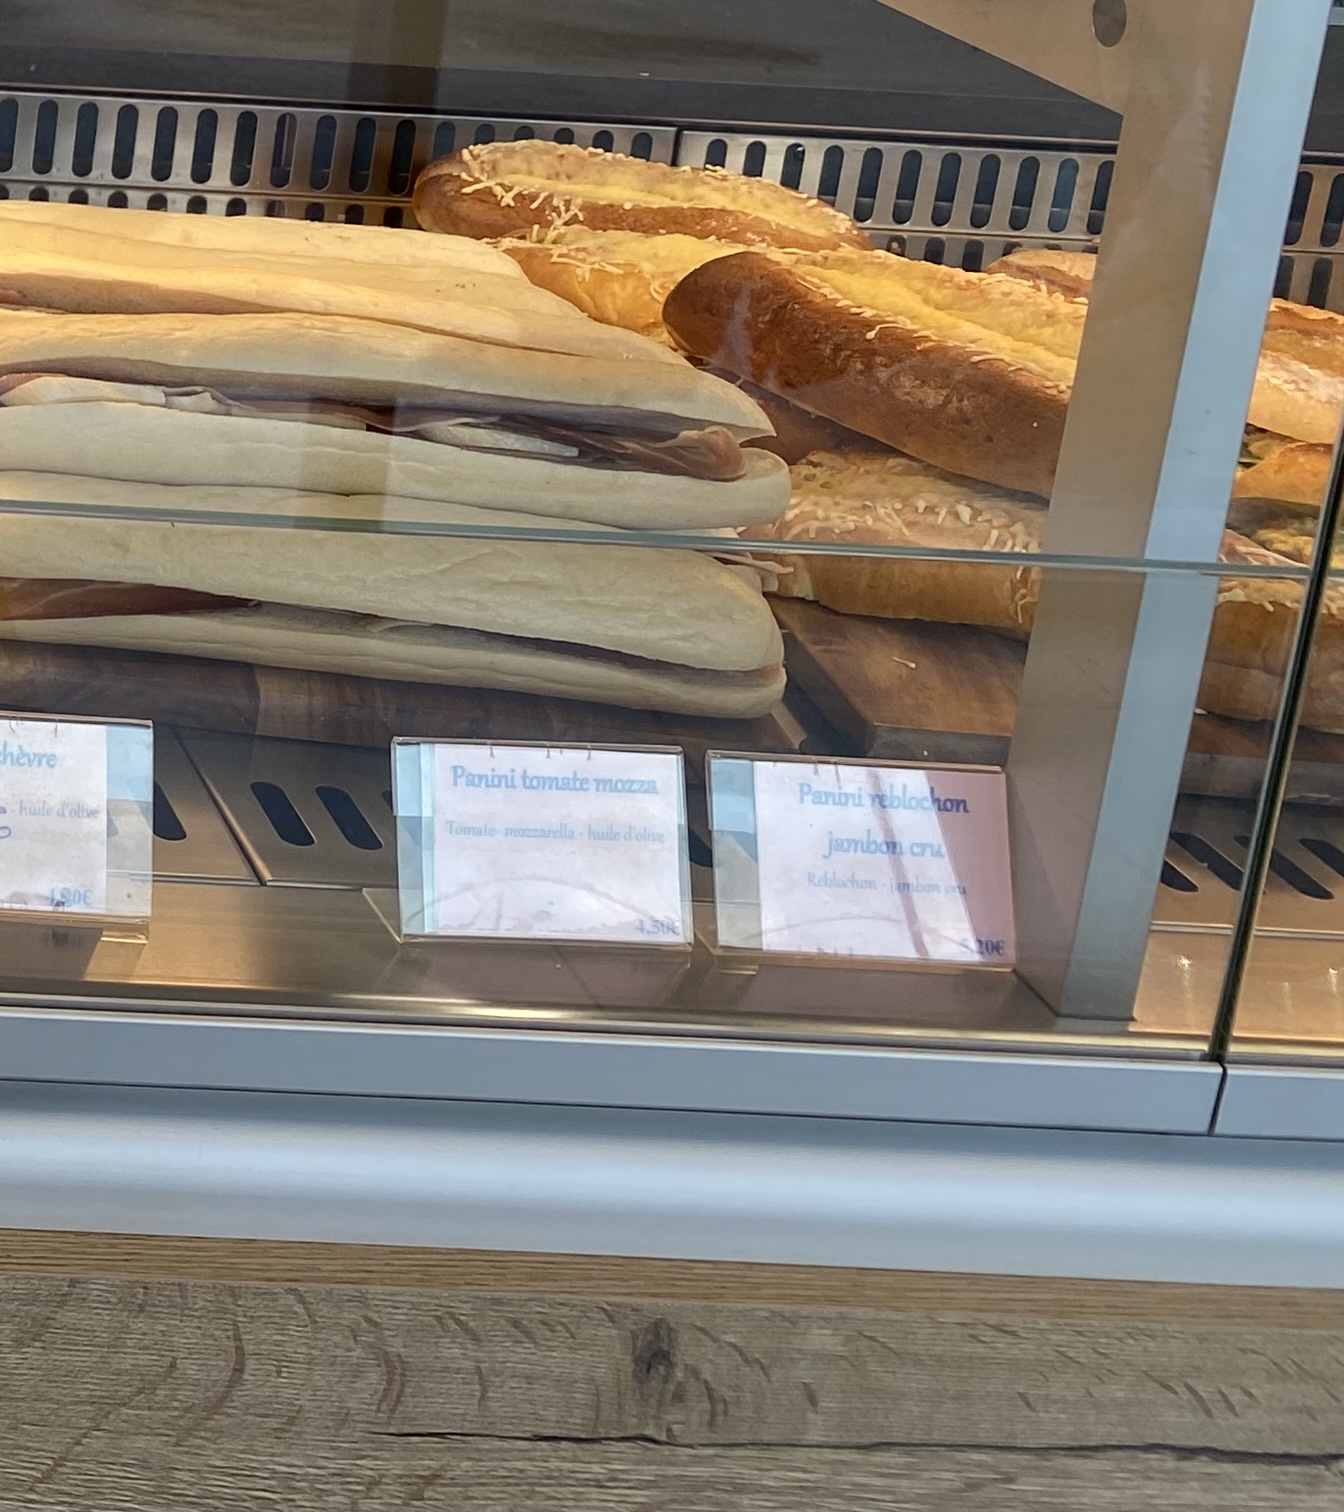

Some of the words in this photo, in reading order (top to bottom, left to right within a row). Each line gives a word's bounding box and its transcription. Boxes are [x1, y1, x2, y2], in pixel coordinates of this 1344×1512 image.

[450, 765, 518, 789] Panini
[520, 770, 590, 793] tomate
[594, 776, 660, 794] mozza
[18, 798, 53, 818] huile
[56, 800, 100, 819] d'olive
[797, 782, 863, 806] Panini
[868, 786, 970, 814] reblochon
[447, 820, 496, 837] Tomate
[504, 823, 575, 840] mozzarella
[587, 824, 621, 842] huile
[623, 825, 666, 844] d'olive
[823, 829, 905, 860] jambon
[909, 839, 945, 859] cru
[807, 872, 878, 891] Reblochon
[889, 875, 941, 895] jambon
[944, 882, 967, 896] cru
